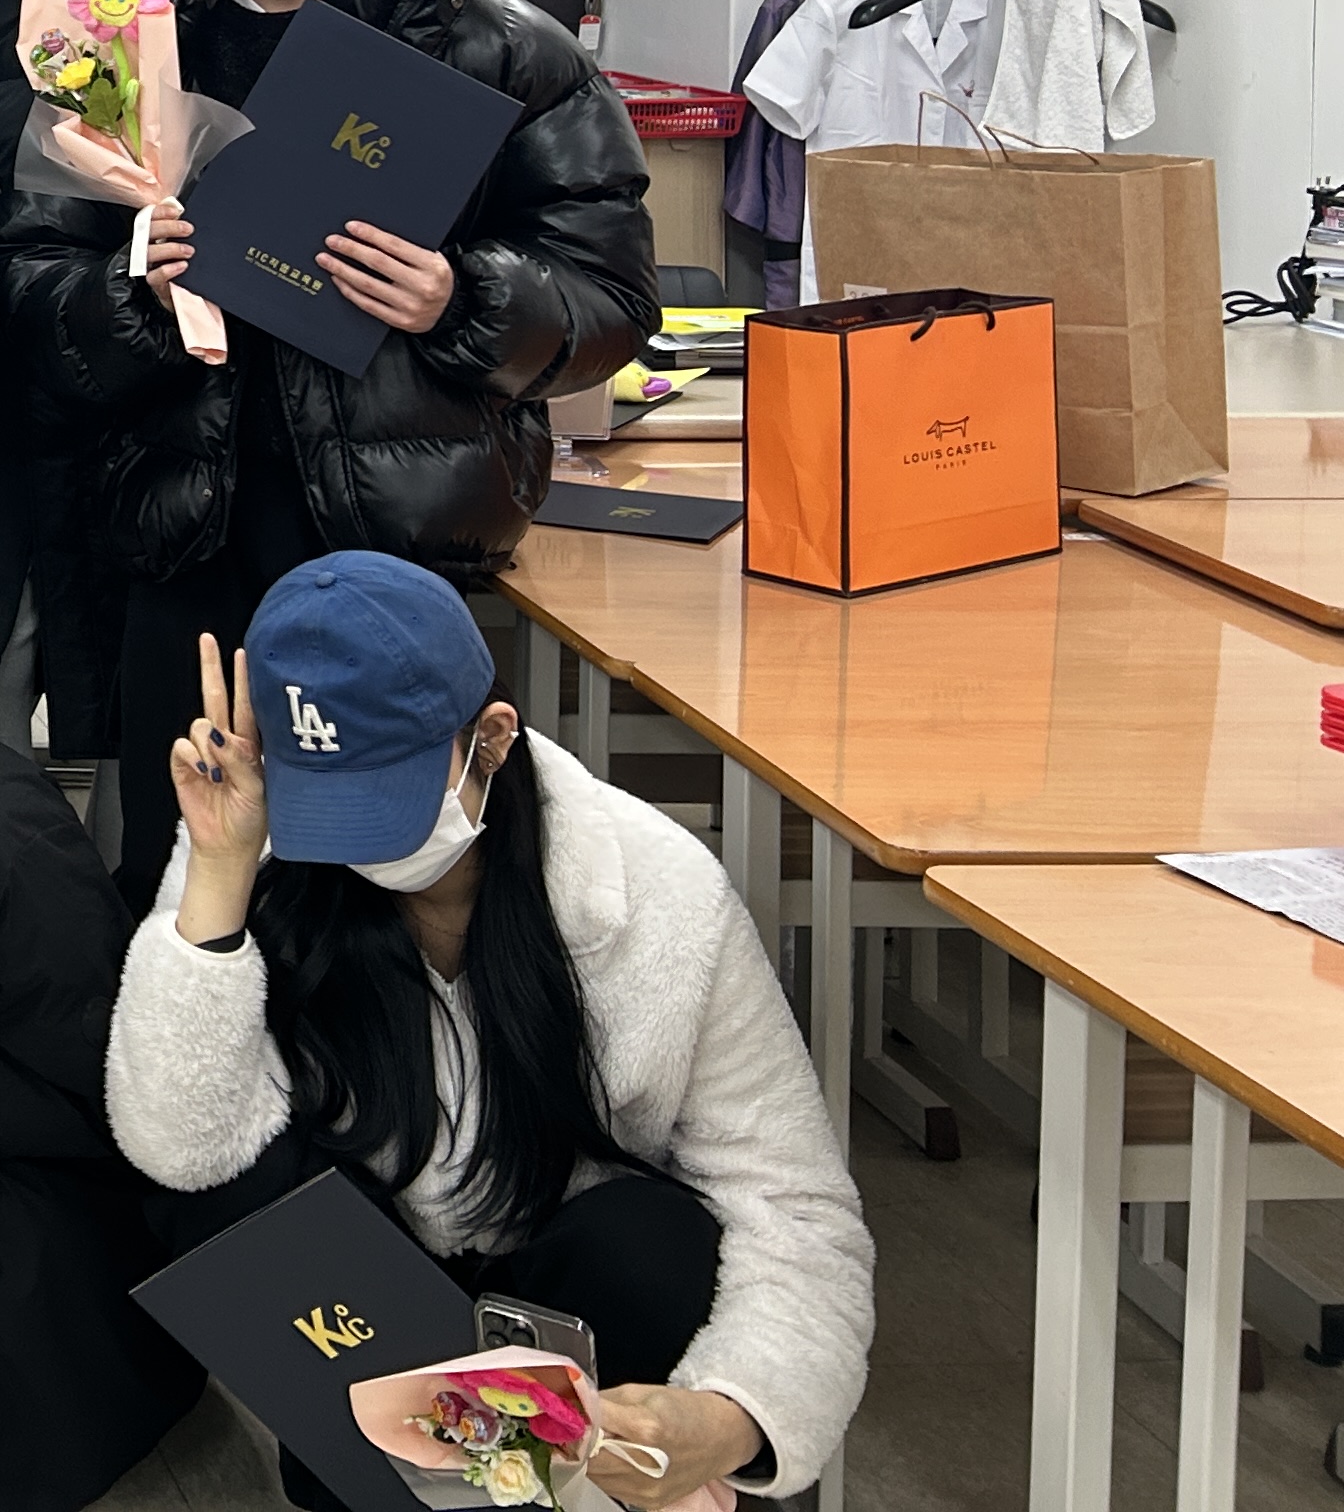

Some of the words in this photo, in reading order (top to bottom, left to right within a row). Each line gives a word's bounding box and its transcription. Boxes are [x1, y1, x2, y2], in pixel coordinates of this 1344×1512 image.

[903, 449, 943, 465] LOUIS
[946, 441, 997, 457] CASTEL
[935, 459, 967, 471] PARIS
[285, 685, 341, 752] LA
